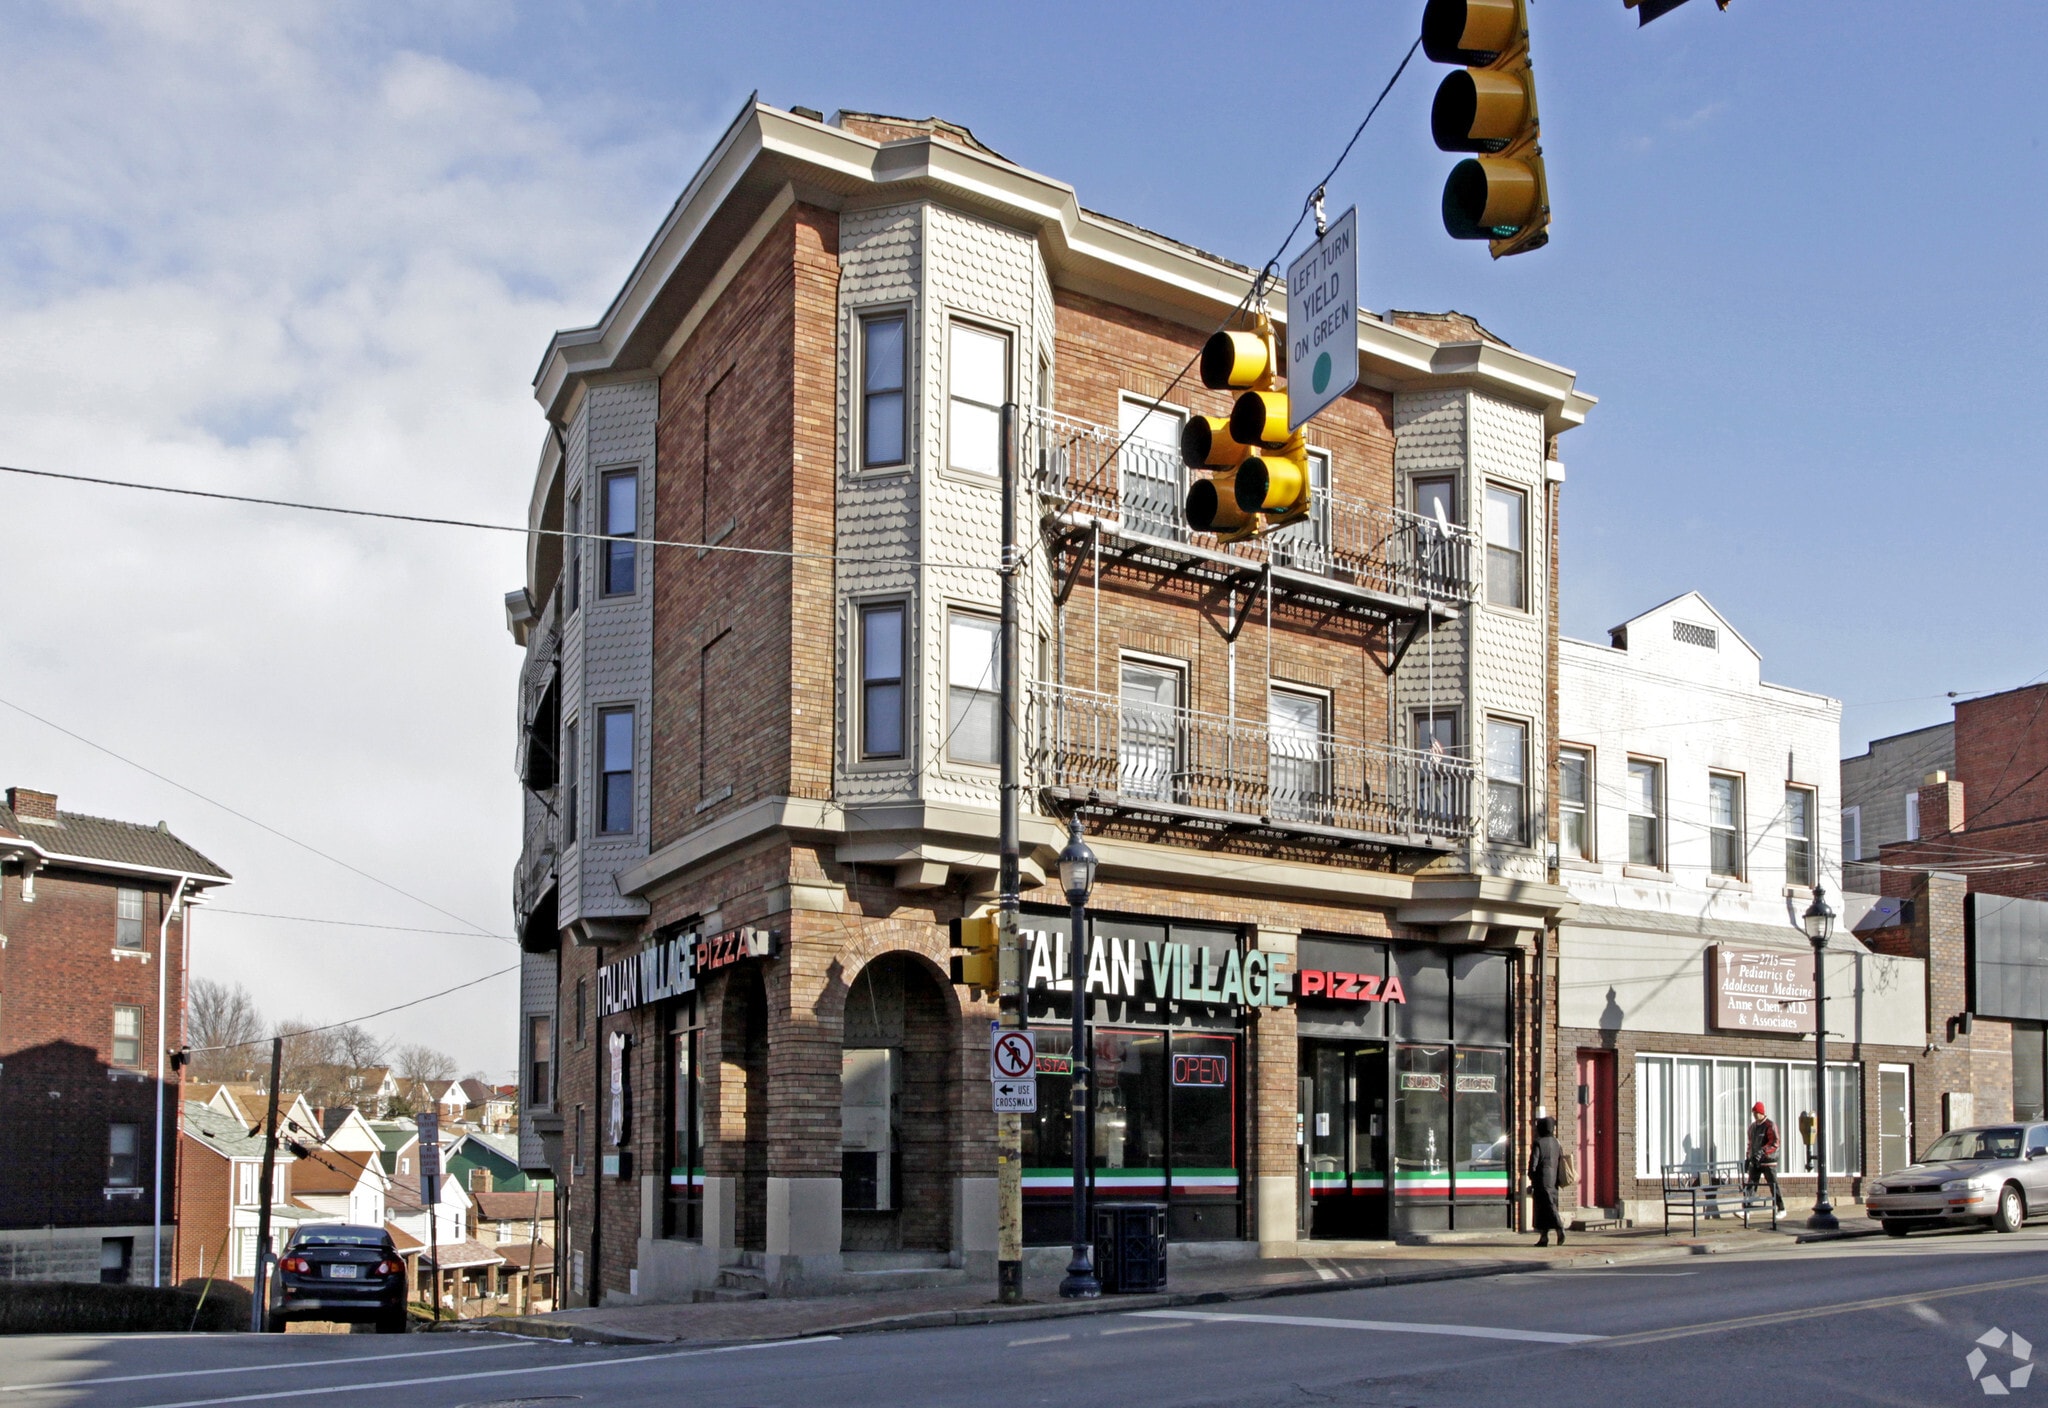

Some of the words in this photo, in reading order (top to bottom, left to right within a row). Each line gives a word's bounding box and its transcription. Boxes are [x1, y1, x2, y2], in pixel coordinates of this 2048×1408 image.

[1293, 257, 1318, 297] LEFT
[1321, 228, 1349, 271] TURN
[1303, 272, 1339, 322] YIELD
[1294, 334, 1309, 363] ON
[1313, 300, 1349, 347] GREEN
[1759, 953, 1779, 967] 2715
[597, 954, 638, 1018] ITALIAN
[639, 932, 696, 1005] VILLAGE
[696, 927, 752, 974] PIZZA
[1147, 940, 1289, 1007] VILLAGE
[1301, 968, 1407, 1005] PIZZA
[1739, 965, 1783, 980] Pediatrics
[1786, 969, 1796, 982] &
[1721, 978, 1768, 994] Adolescent
[1772, 982, 1812, 997] Medicine
[1728, 997, 1753, 1011] Anne
[1786, 1002, 1808, 1015] M.D.
[1738, 1013, 1747, 1025] &
[1752, 1014, 1797, 1029] Associates
[1036, 1058, 1069, 1073] ASTA
[1175, 1057, 1225, 1084] OPEN
[1018, 1085, 1030, 1095] USE
[995, 1097, 1033, 1107] CROSSWALK
